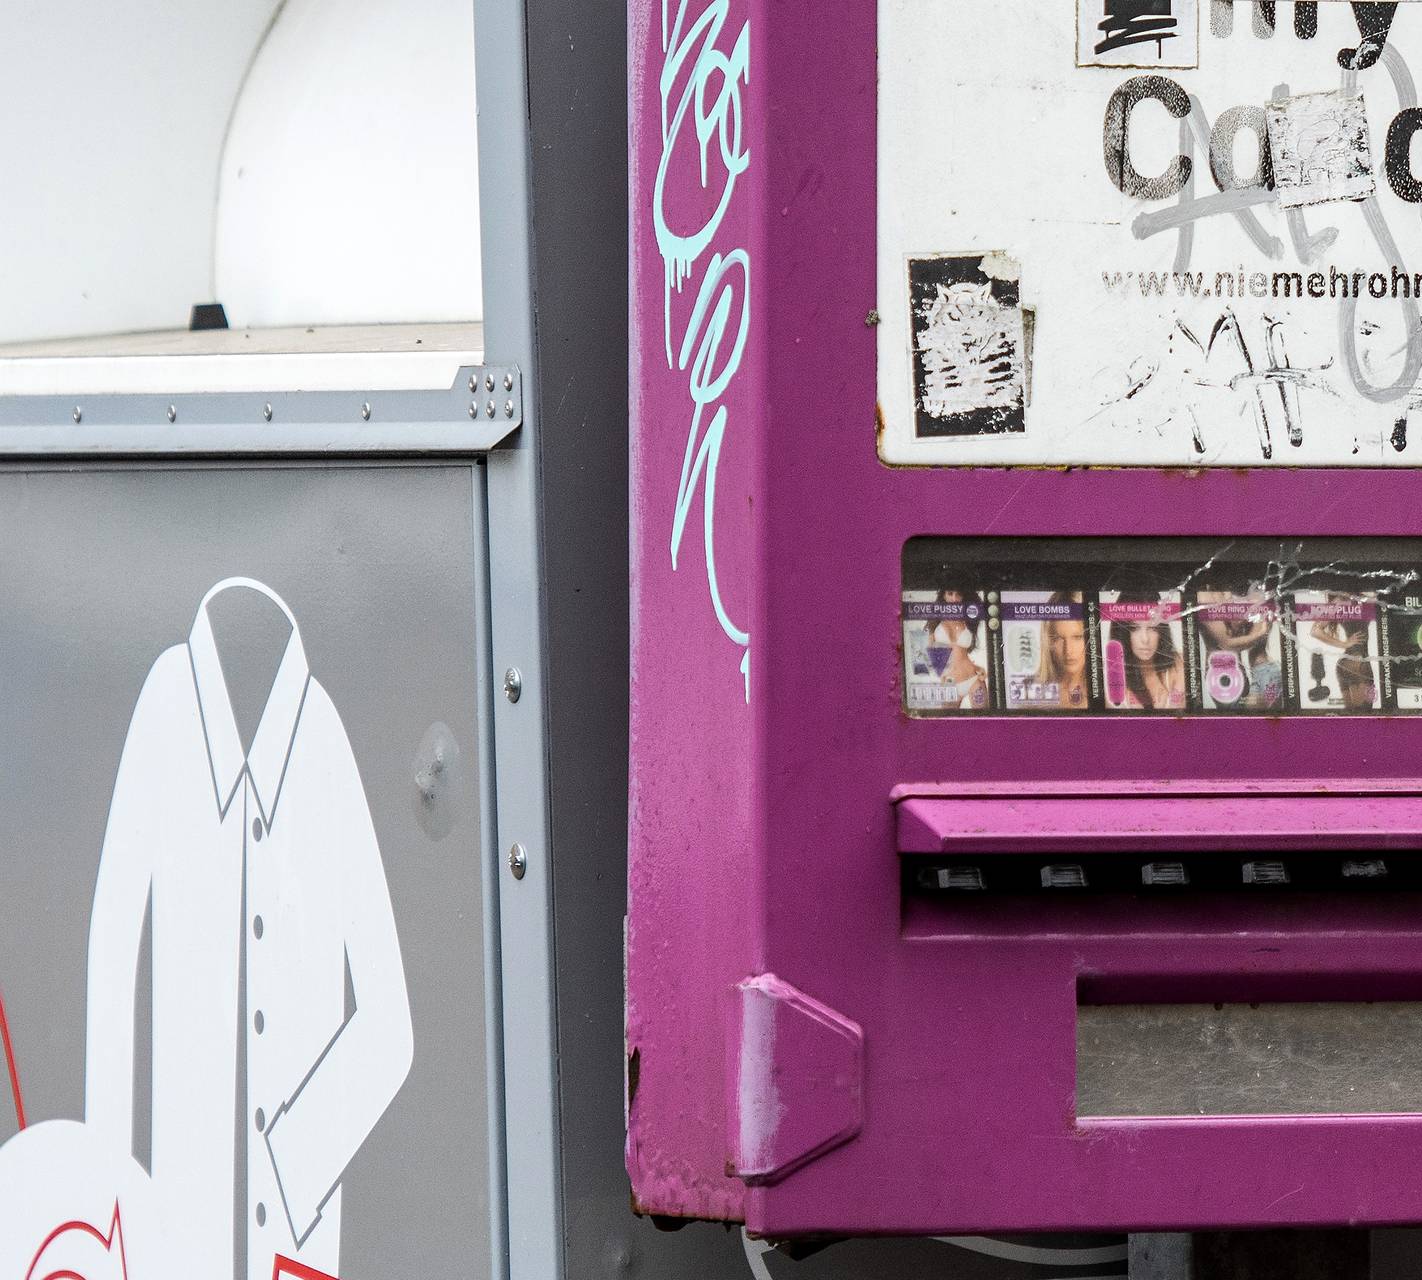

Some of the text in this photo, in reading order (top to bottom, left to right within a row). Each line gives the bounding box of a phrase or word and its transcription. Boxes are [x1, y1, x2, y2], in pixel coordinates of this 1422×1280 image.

[908, 605, 932, 614] LOVE
[934, 605, 963, 614] PUSSY
[1014, 605, 1071, 614] LOVE BOMBS
[1109, 605, 1126, 613] LOVE
[1127, 605, 1151, 613] BULLET
[1228, 605, 1246, 613] RING
[1337, 605, 1362, 615] PLUG
